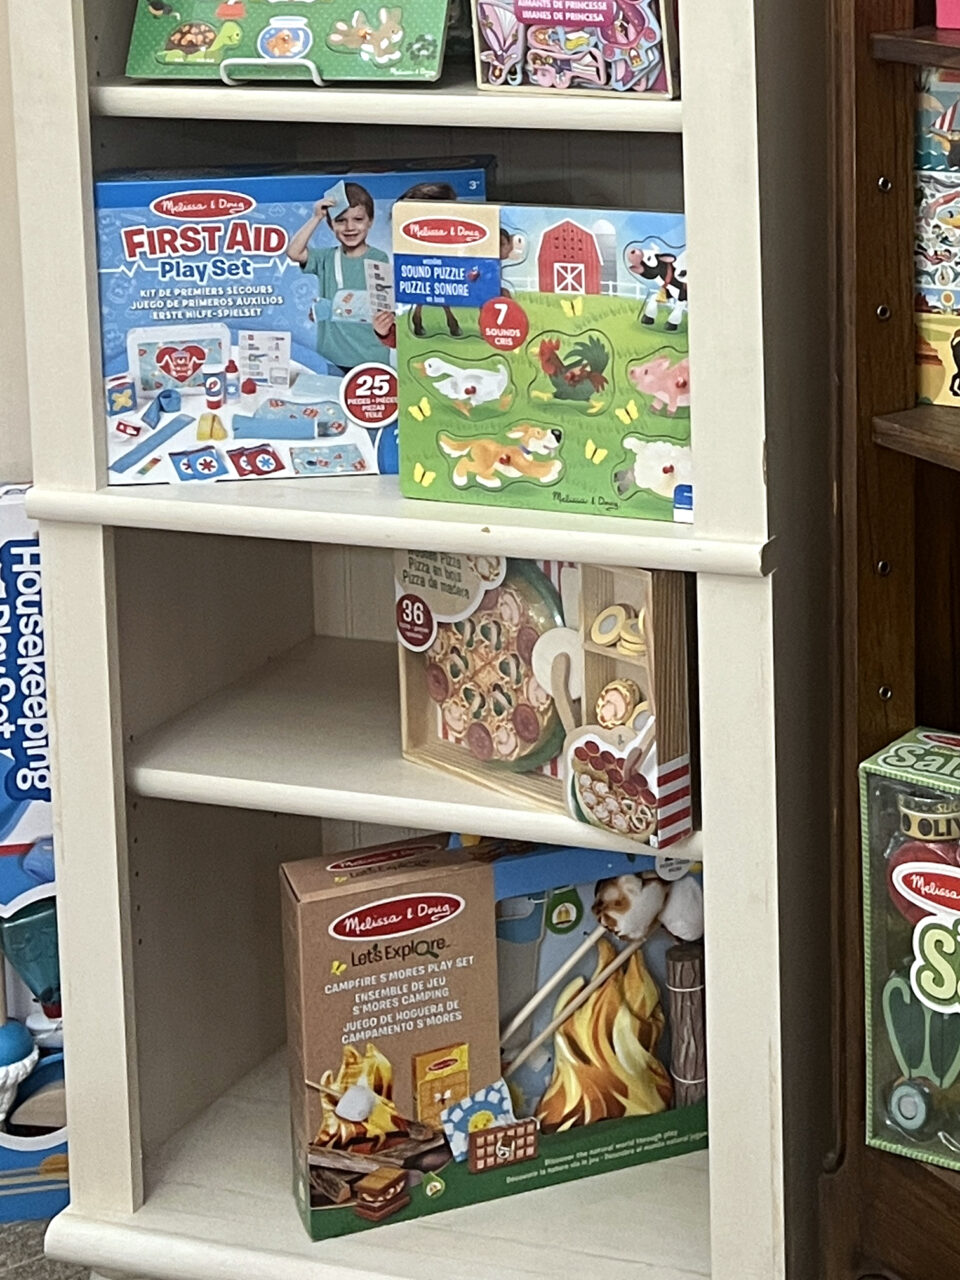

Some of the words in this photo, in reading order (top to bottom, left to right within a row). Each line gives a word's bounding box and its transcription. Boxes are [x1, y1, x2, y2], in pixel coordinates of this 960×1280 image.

[162, 199, 207, 212] Melissa
[218, 198, 245, 214] Doug
[123, 225, 223, 259] FIRST
[227, 222, 288, 252] AID
[160, 260, 206, 281] Play
[212, 259, 251, 278] Set
[401, 265, 431, 278] SOUND
[434, 267, 465, 280] PUZZLE
[140, 289, 155, 297] KIT
[174, 287, 223, 296] PREMIERS
[227, 286, 273, 294] SECOURS
[400, 281, 431, 294] PUZZLE
[434, 283, 469, 296] SONORE
[131, 301, 164, 309] JUEGO
[182, 298, 233, 307] PRIMEROS
[236, 296, 283, 305] AUXILIOS
[493, 303, 508, 325] 7
[485, 328, 520, 337] SOUNDS
[495, 337, 513, 346] CRIS
[355, 375, 390, 396] 25
[403, 600, 423, 624] 36
[10, 546, 51, 791] Housekeeping
[344, 913, 403, 935] Melissa
[417, 901, 452, 920] Doug
[351, 946, 383, 967] Let's
[324, 975, 377, 994] CAMPFIRE
[379, 965, 426, 986] S'MORES
[428, 960, 453, 976] PLAY
[456, 955, 475, 970] SET
[355, 984, 410, 1004] ENSEMBLE
[411, 981, 425, 995] DE
[428, 976, 446, 992] JEU
[352, 998, 399, 1016] S'MORES
[402, 987, 449, 1009] CAMPING
[341, 1023, 415, 1045] CAMPAMENTO
[417, 1011, 462, 1030] S'MORES
[342, 1017, 376, 1033] JUEGO
[379, 1015, 393, 1028] DE
[395, 1004, 445, 1025] HOGUERA
[447, 1001, 459, 1014] DE
